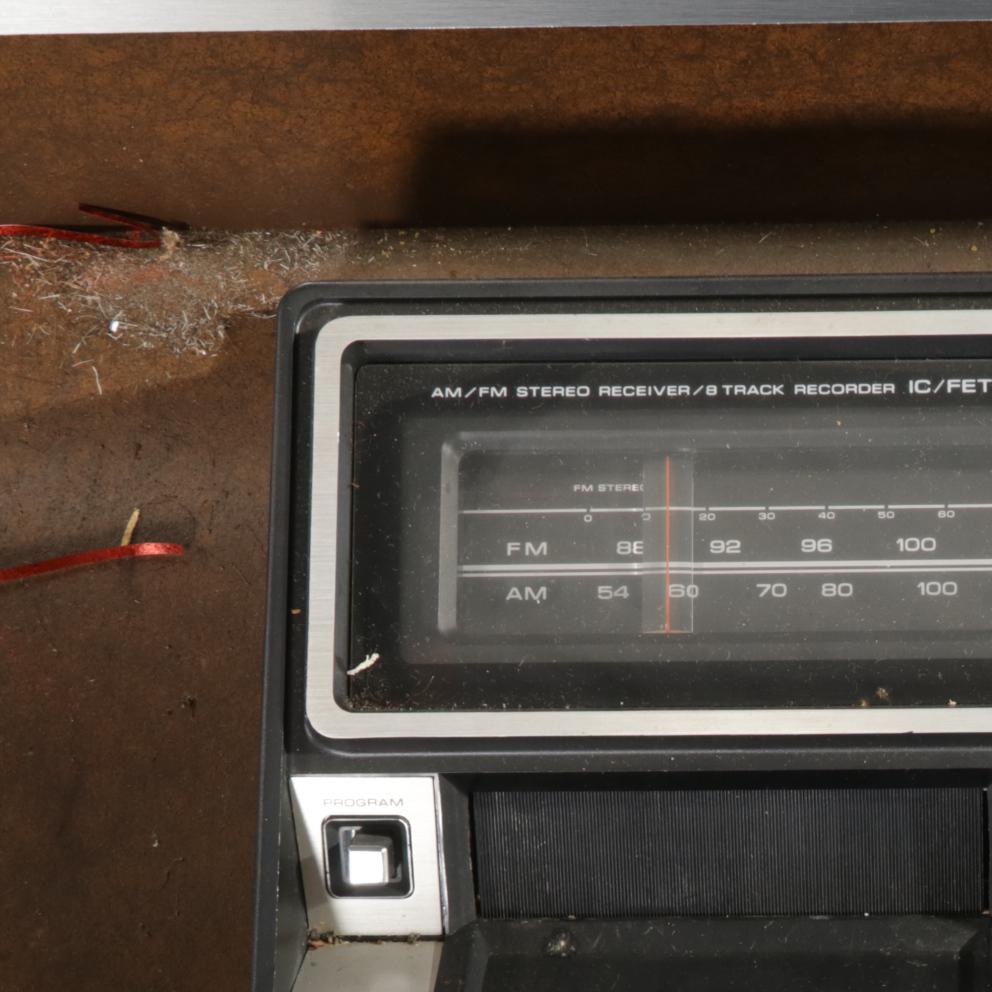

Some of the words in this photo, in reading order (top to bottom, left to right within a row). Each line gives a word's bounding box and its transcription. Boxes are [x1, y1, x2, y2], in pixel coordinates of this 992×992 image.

[431, 386, 508, 399] AM/FM
[516, 385, 591, 398] STEREO
[721, 384, 785, 396] TRACK
[794, 383, 896, 396] RECORDER
[908, 378, 992, 394] IC/FET
[573, 484, 594, 492] FM
[584, 514, 592, 522] 0
[699, 513, 716, 521] 20
[758, 511, 776, 521] 30
[818, 511, 836, 520] 40
[877, 510, 895, 519] 50
[937, 510, 955, 519] 60
[506, 541, 548, 556] FM
[709, 539, 741, 554] 92
[801, 538, 833, 553] 96
[896, 537, 937, 552] 100
[506, 586, 548, 601] AM
[597, 585, 630, 600] 54
[668, 584, 699, 598] 60
[756, 582, 788, 598] 70
[821, 582, 854, 597] 80
[917, 581, 958, 596] 100
[323, 797, 404, 808] PROGRAM
